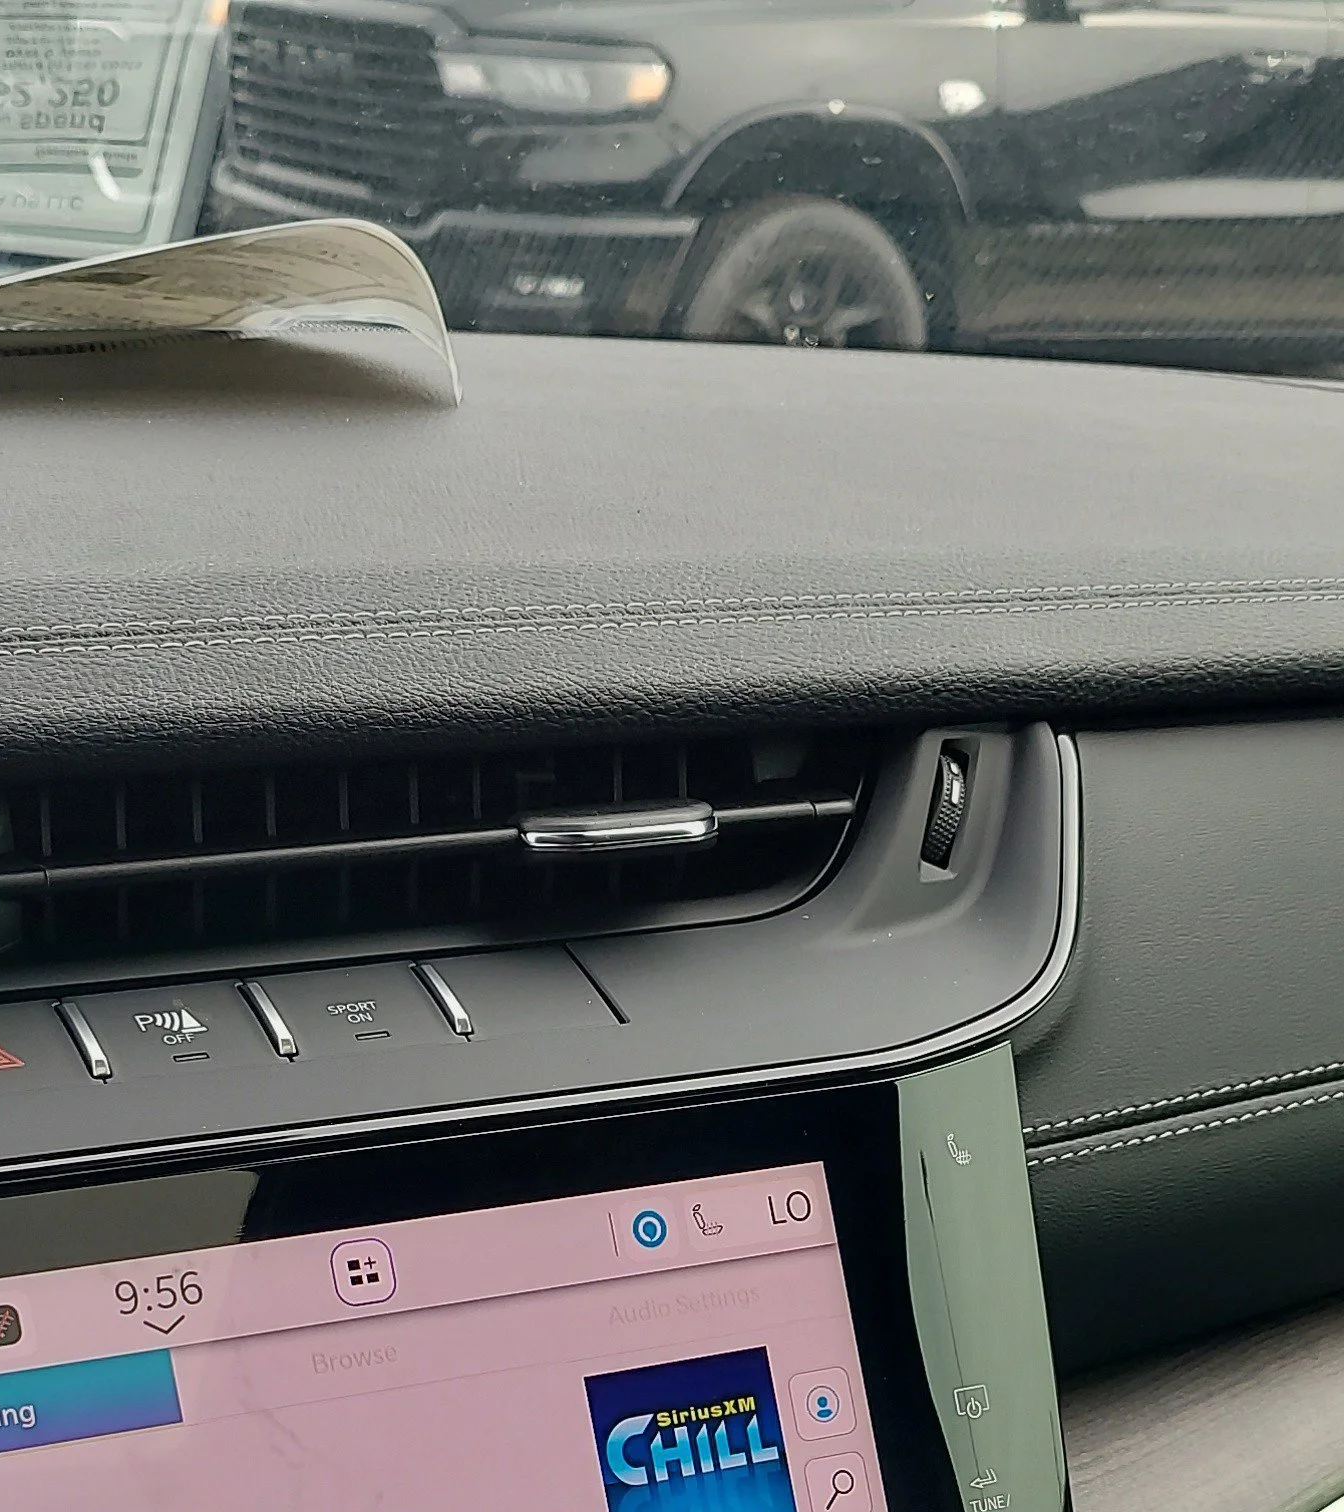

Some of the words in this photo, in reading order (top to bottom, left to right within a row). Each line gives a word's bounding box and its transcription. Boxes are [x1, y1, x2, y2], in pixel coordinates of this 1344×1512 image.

[327, 1000, 377, 1018] SPORT
[346, 1011, 374, 1025] ON
[162, 1031, 196, 1045] OFF
[767, 1189, 812, 1226] LO
[114, 1270, 204, 1316] 9:56
[311, 1341, 398, 1376] Browse
[656, 1396, 756, 1428] SiriusXM
[605, 1412, 780, 1487] CHILL
